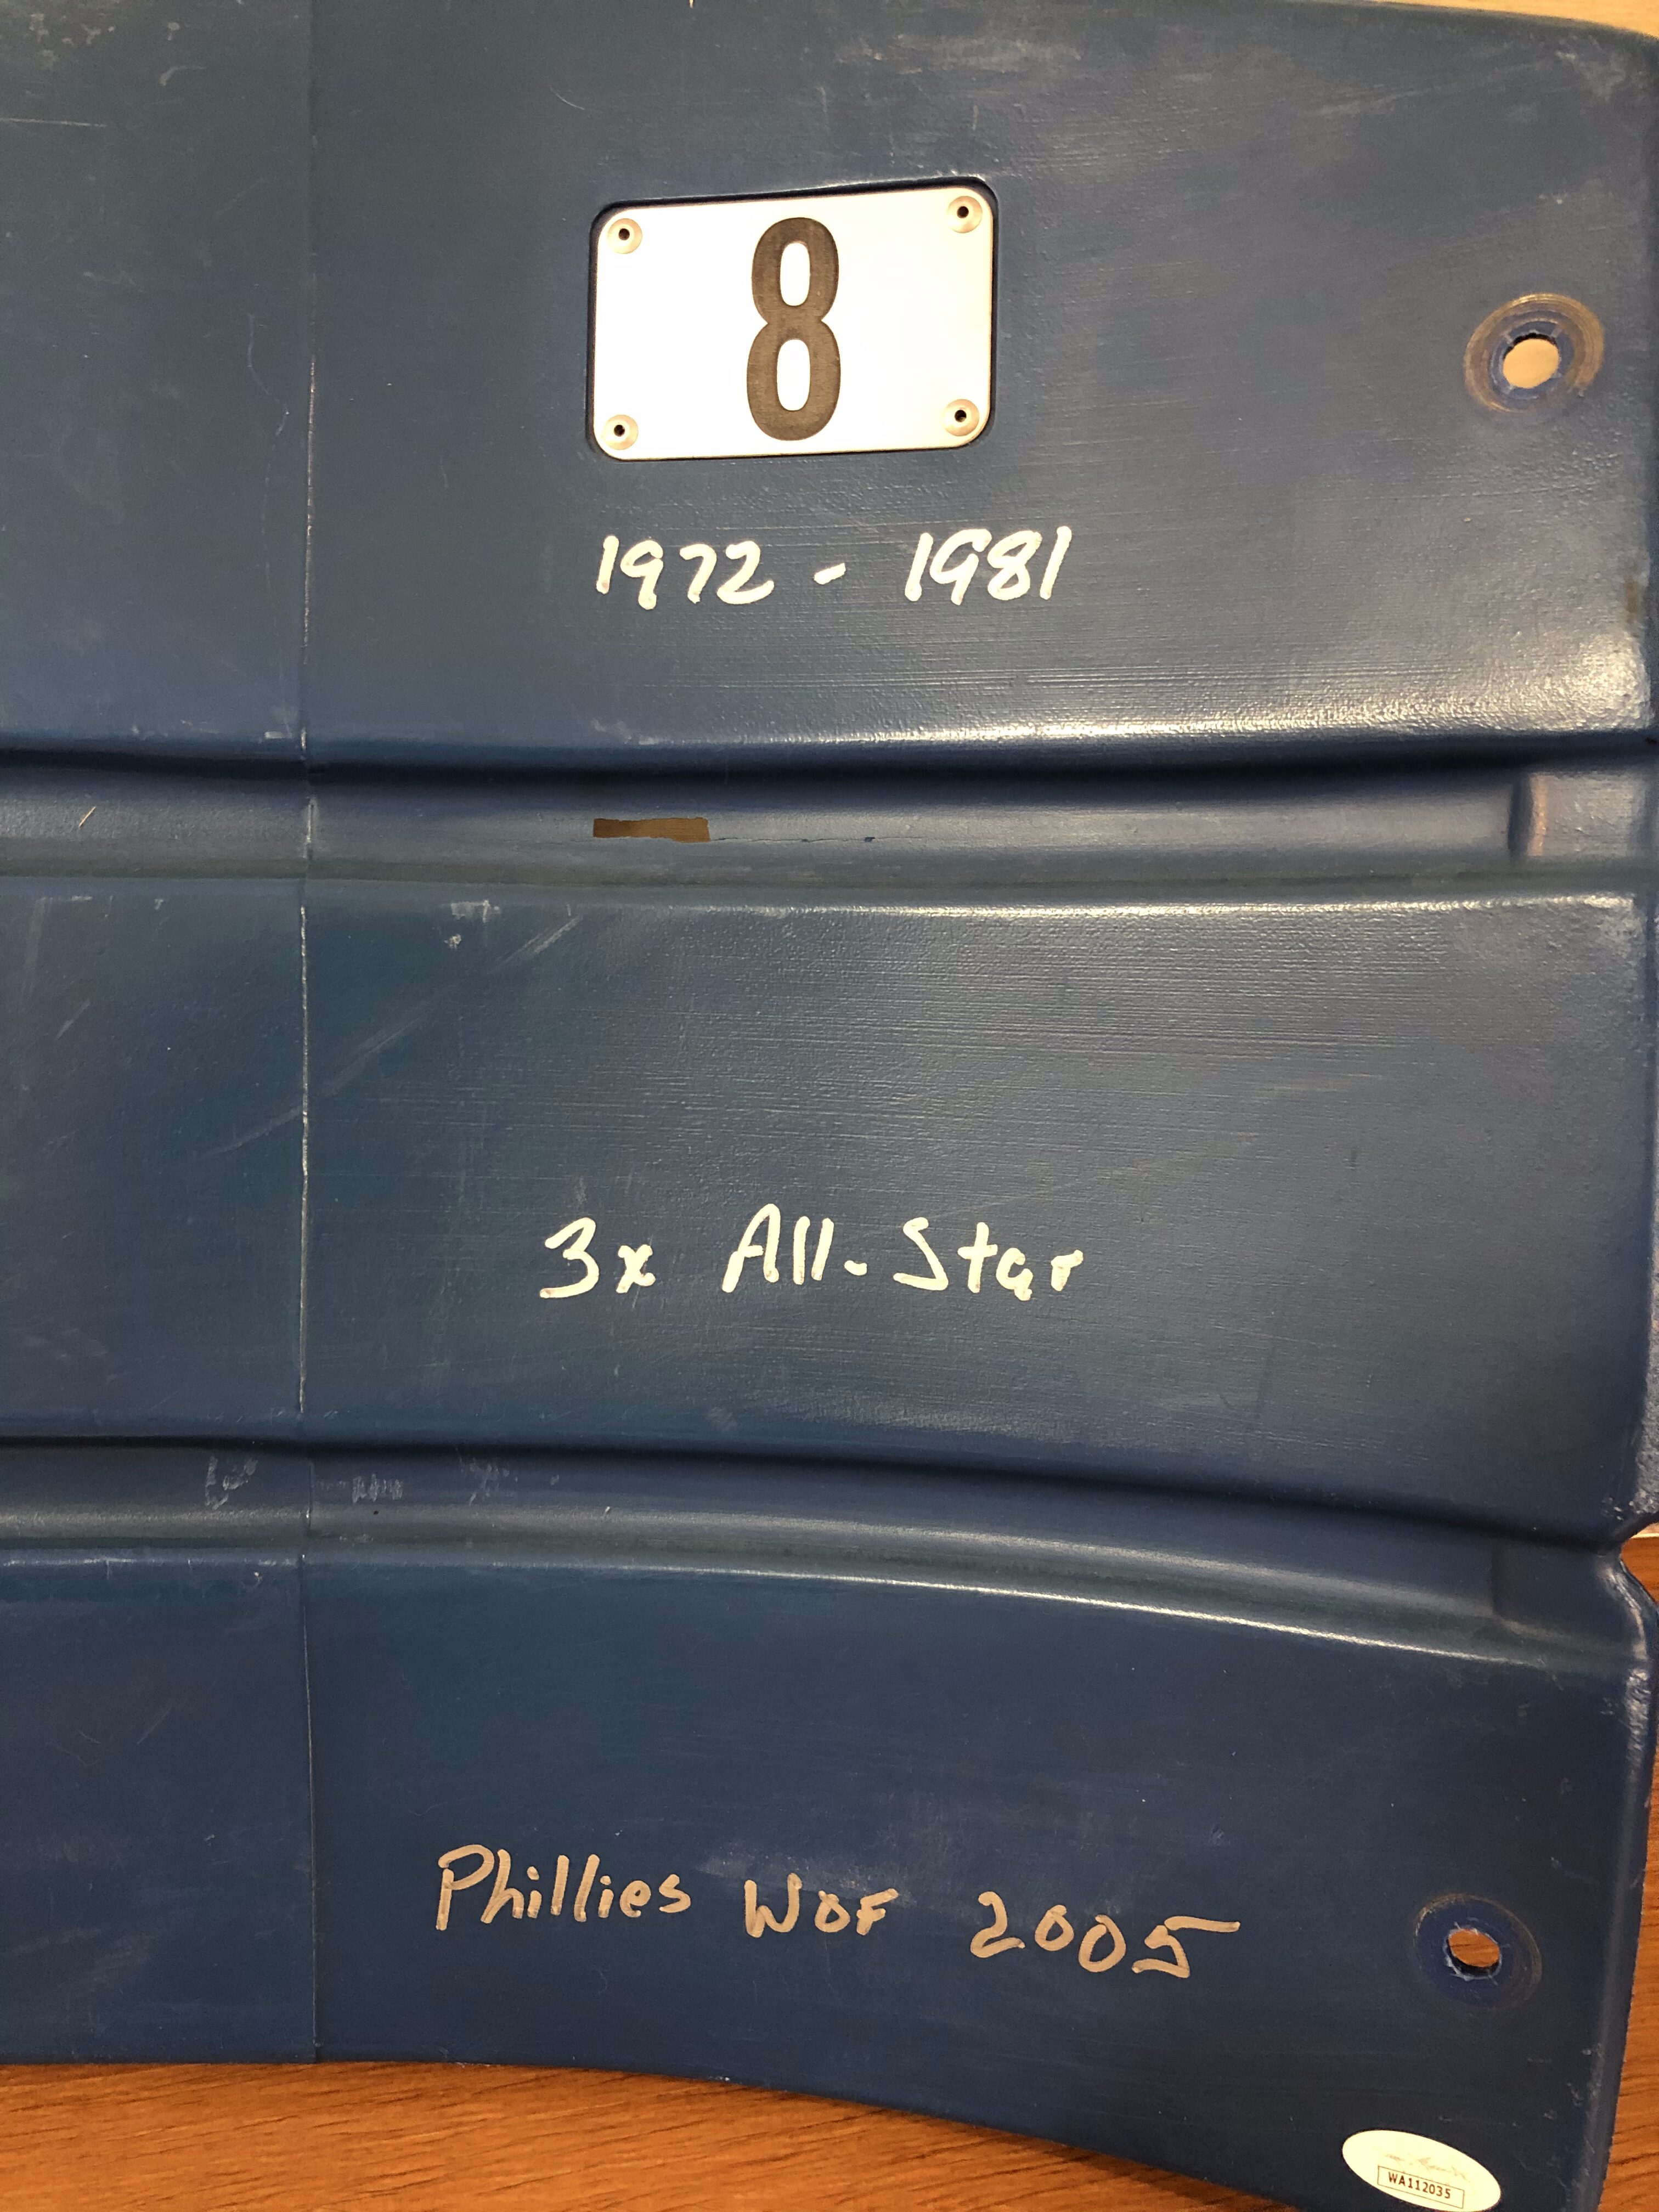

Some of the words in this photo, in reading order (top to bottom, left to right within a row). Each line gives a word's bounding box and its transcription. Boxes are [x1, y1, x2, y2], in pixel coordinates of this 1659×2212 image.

[747, 217, 840, 441] 8
[596, 535, 774, 610] 1972
[905, 523, 1073, 606] 1981
[540, 1217, 656, 1298] 3x
[721, 1204, 1084, 1301] All-Star
[436, 1844, 690, 1930] Phillies
[970, 1892, 1240, 1978] 2005
[1388, 2171, 1451, 2199] WA112035
